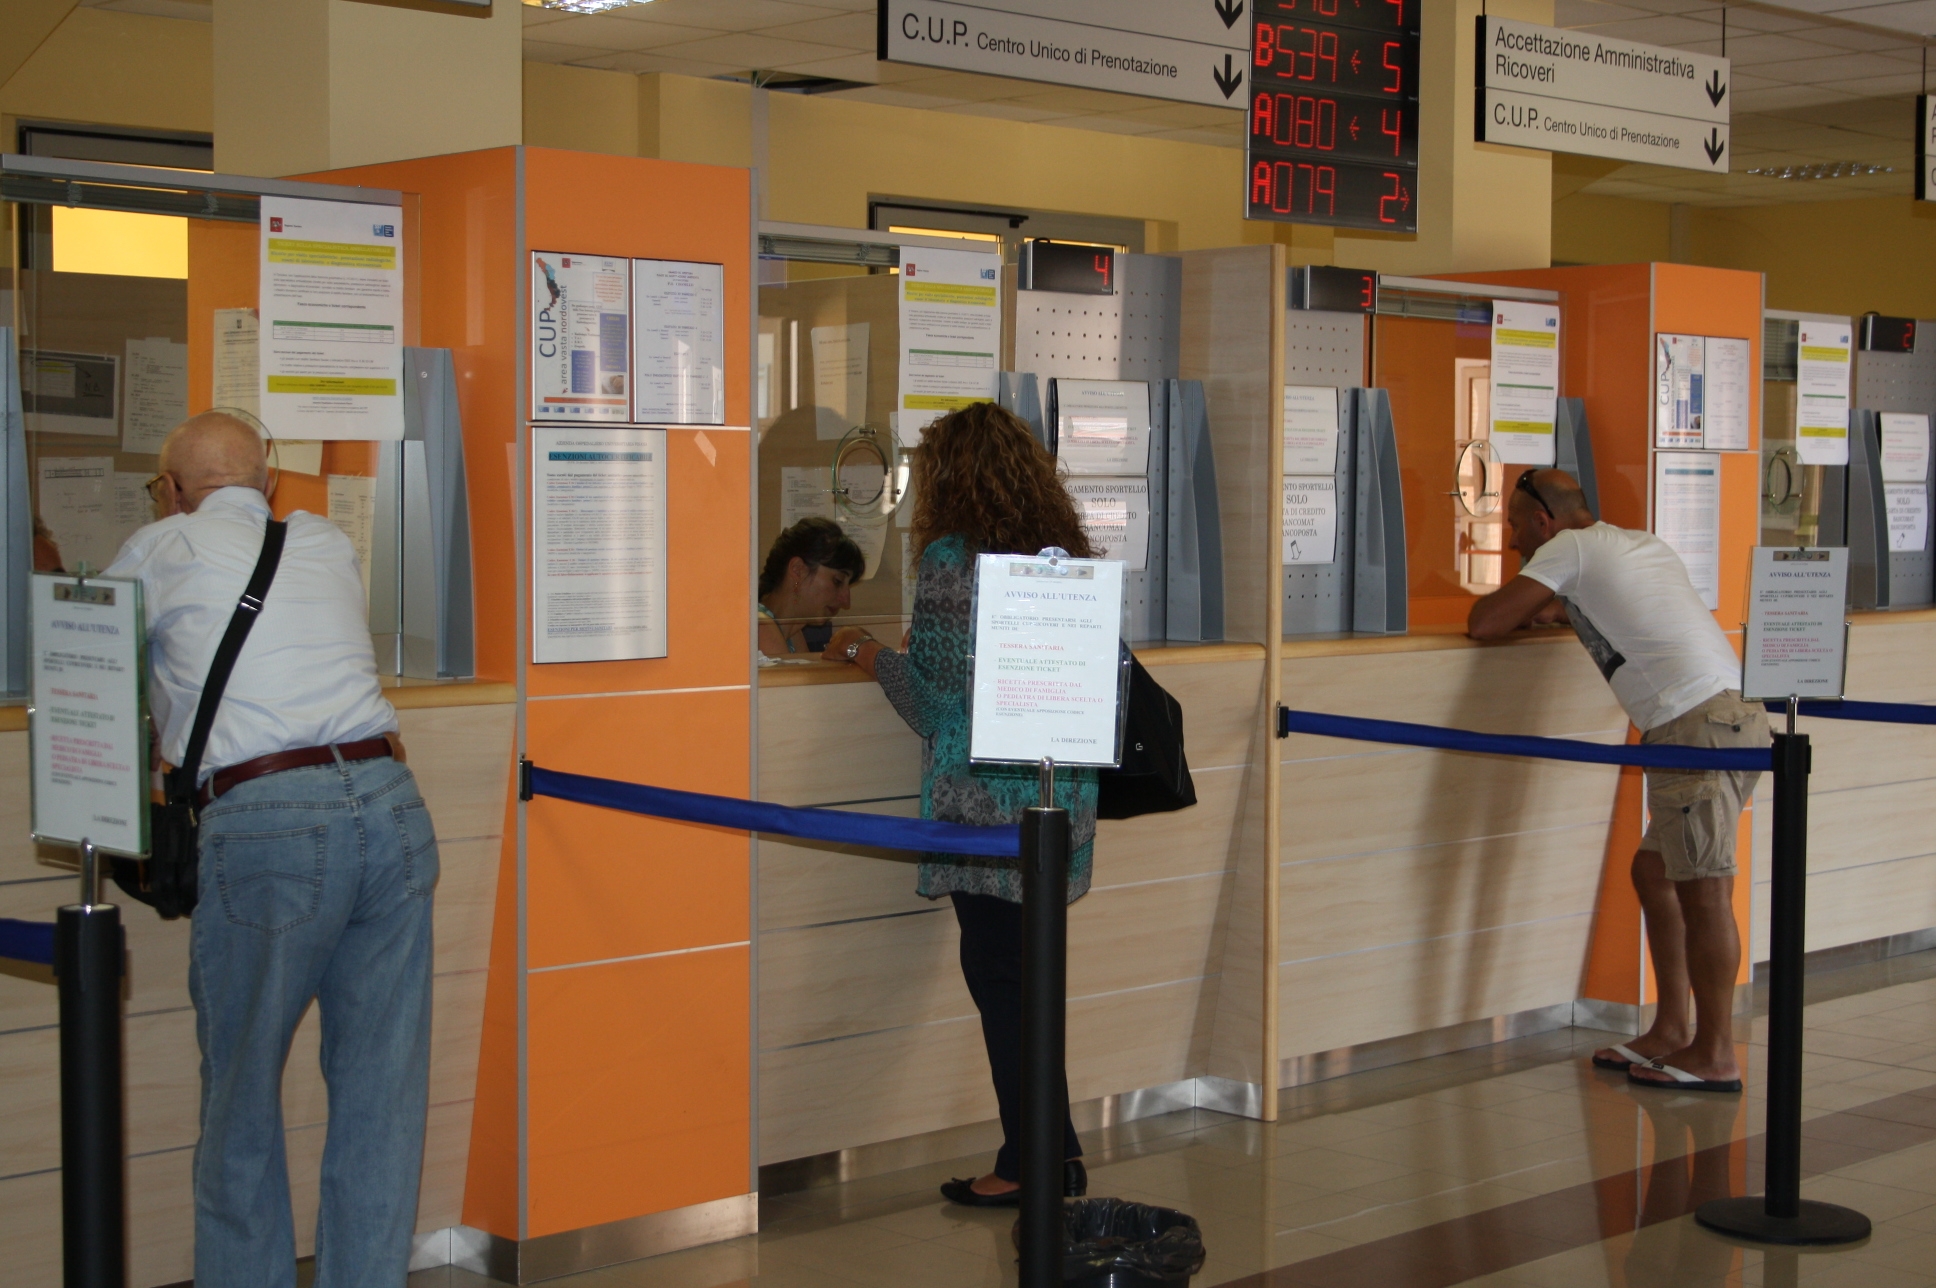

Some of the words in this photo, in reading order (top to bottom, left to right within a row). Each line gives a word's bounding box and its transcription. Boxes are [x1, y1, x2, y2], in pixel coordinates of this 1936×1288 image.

[902, 13, 969, 47] C.U.P.
[977, 32, 1026, 55] Centro
[1030, 40, 1070, 62] Unico
[1074, 48, 1087, 64] di
[1091, 49, 1178, 78] Prenotazione
[1495, 26, 1590, 62] Accettazione
[1594, 43, 1695, 80] Amministrativa
[1383, 42, 1401, 92] 5
[1495, 54, 1555, 83] Ricoveri
[1382, 109, 1401, 156] 4
[1494, 103, 1539, 129] C.U.P.
[1544, 116, 1577, 135] Centro
[1580, 121, 1607, 140] Unico
[1609, 126, 1619, 141] di
[1621, 127, 1680, 149] Prenotazione
[1380, 172, 1400, 223] 2
[1094, 255, 1110, 286] 4
[1361, 276, 1372, 307] 3
[559, 285, 567, 333] nordovest
[538, 310, 557, 358] CUP
[1903, 323, 1913, 348] 2
[1063, 485, 1104, 494] AGAMENTO
[1105, 485, 1147, 494] SPORTELLO
[1286, 494, 1308, 504] SOLO
[1298, 483, 1334, 491] SPORTELLO
[1091, 498, 1116, 508] SOLO
[1298, 508, 1326, 516] CREDITO
[1004, 591, 1038, 599] AVVISO
[1041, 592, 1097, 602] ALL'UTENZA
